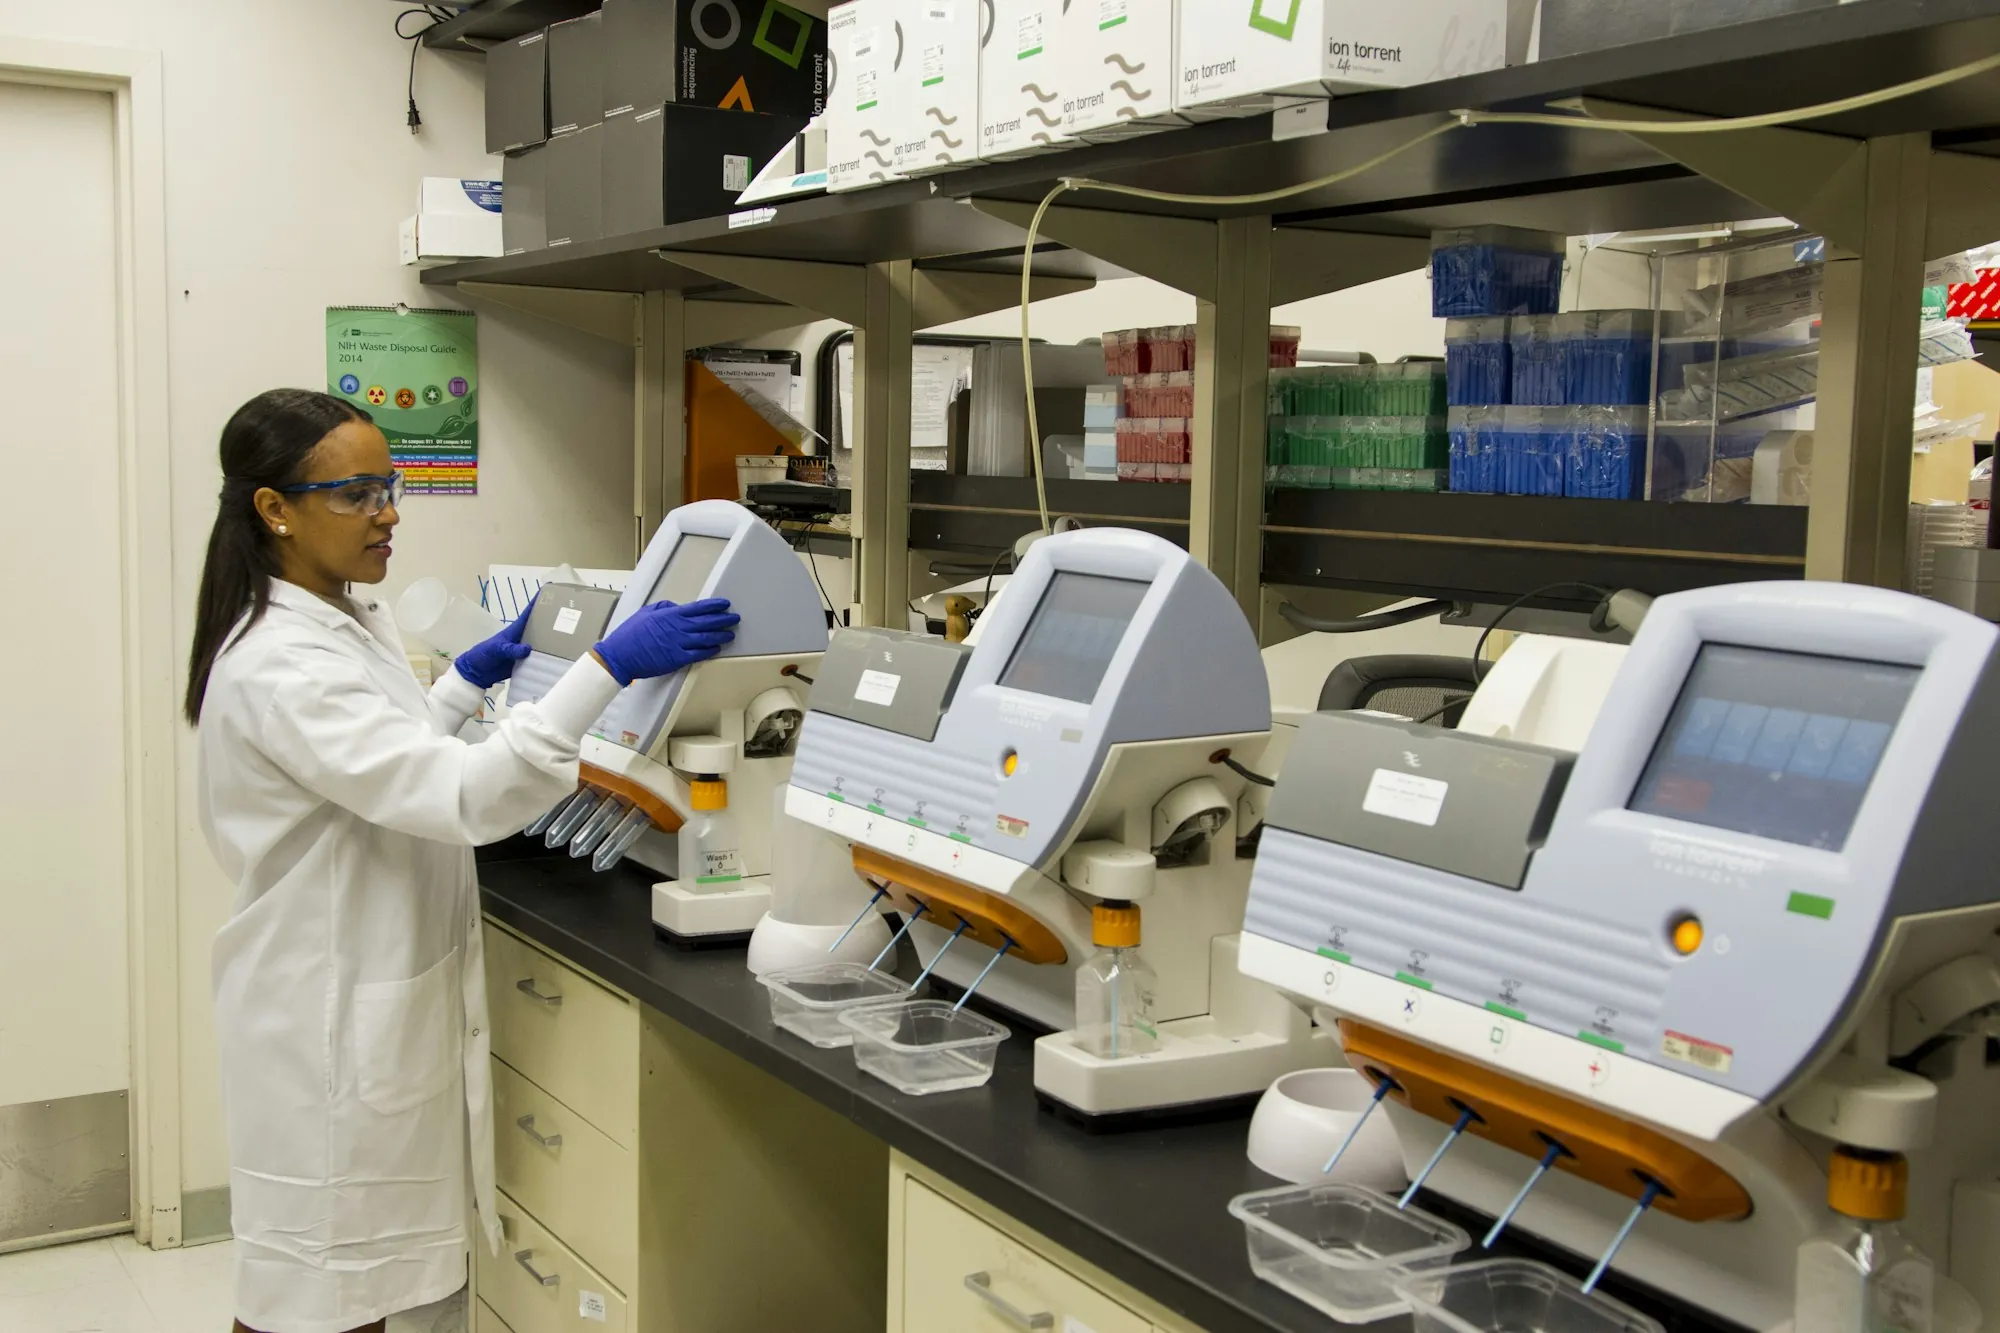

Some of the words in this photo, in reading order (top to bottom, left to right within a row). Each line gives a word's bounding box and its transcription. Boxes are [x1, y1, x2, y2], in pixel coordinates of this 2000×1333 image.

[1329, 37, 1349, 56] ion
[1354, 41, 1401, 62] torrent
[689, 48, 698, 99] sequencing
[813, 53, 823, 94] torrent
[1184, 66, 1199, 82] ion
[1201, 57, 1236, 79] torrent
[812, 99, 822, 115] ion
[1063, 100, 1075, 113] ion
[1077, 91, 1104, 110] torrent
[984, 124, 994, 136] ion
[996, 117, 1021, 134] torrent
[894, 145, 903, 155] ion
[904, 139, 926, 153] torrent
[829, 164, 838, 174] ion
[840, 158, 860, 172] torrent
[338, 341, 356, 351] NIH
[360, 342, 387, 351] Waste
[390, 343, 428, 354] Disposal
[430, 344, 457, 354] Guide
[339, 354, 363, 363] 2014
[706, 853, 728, 862] Wash
